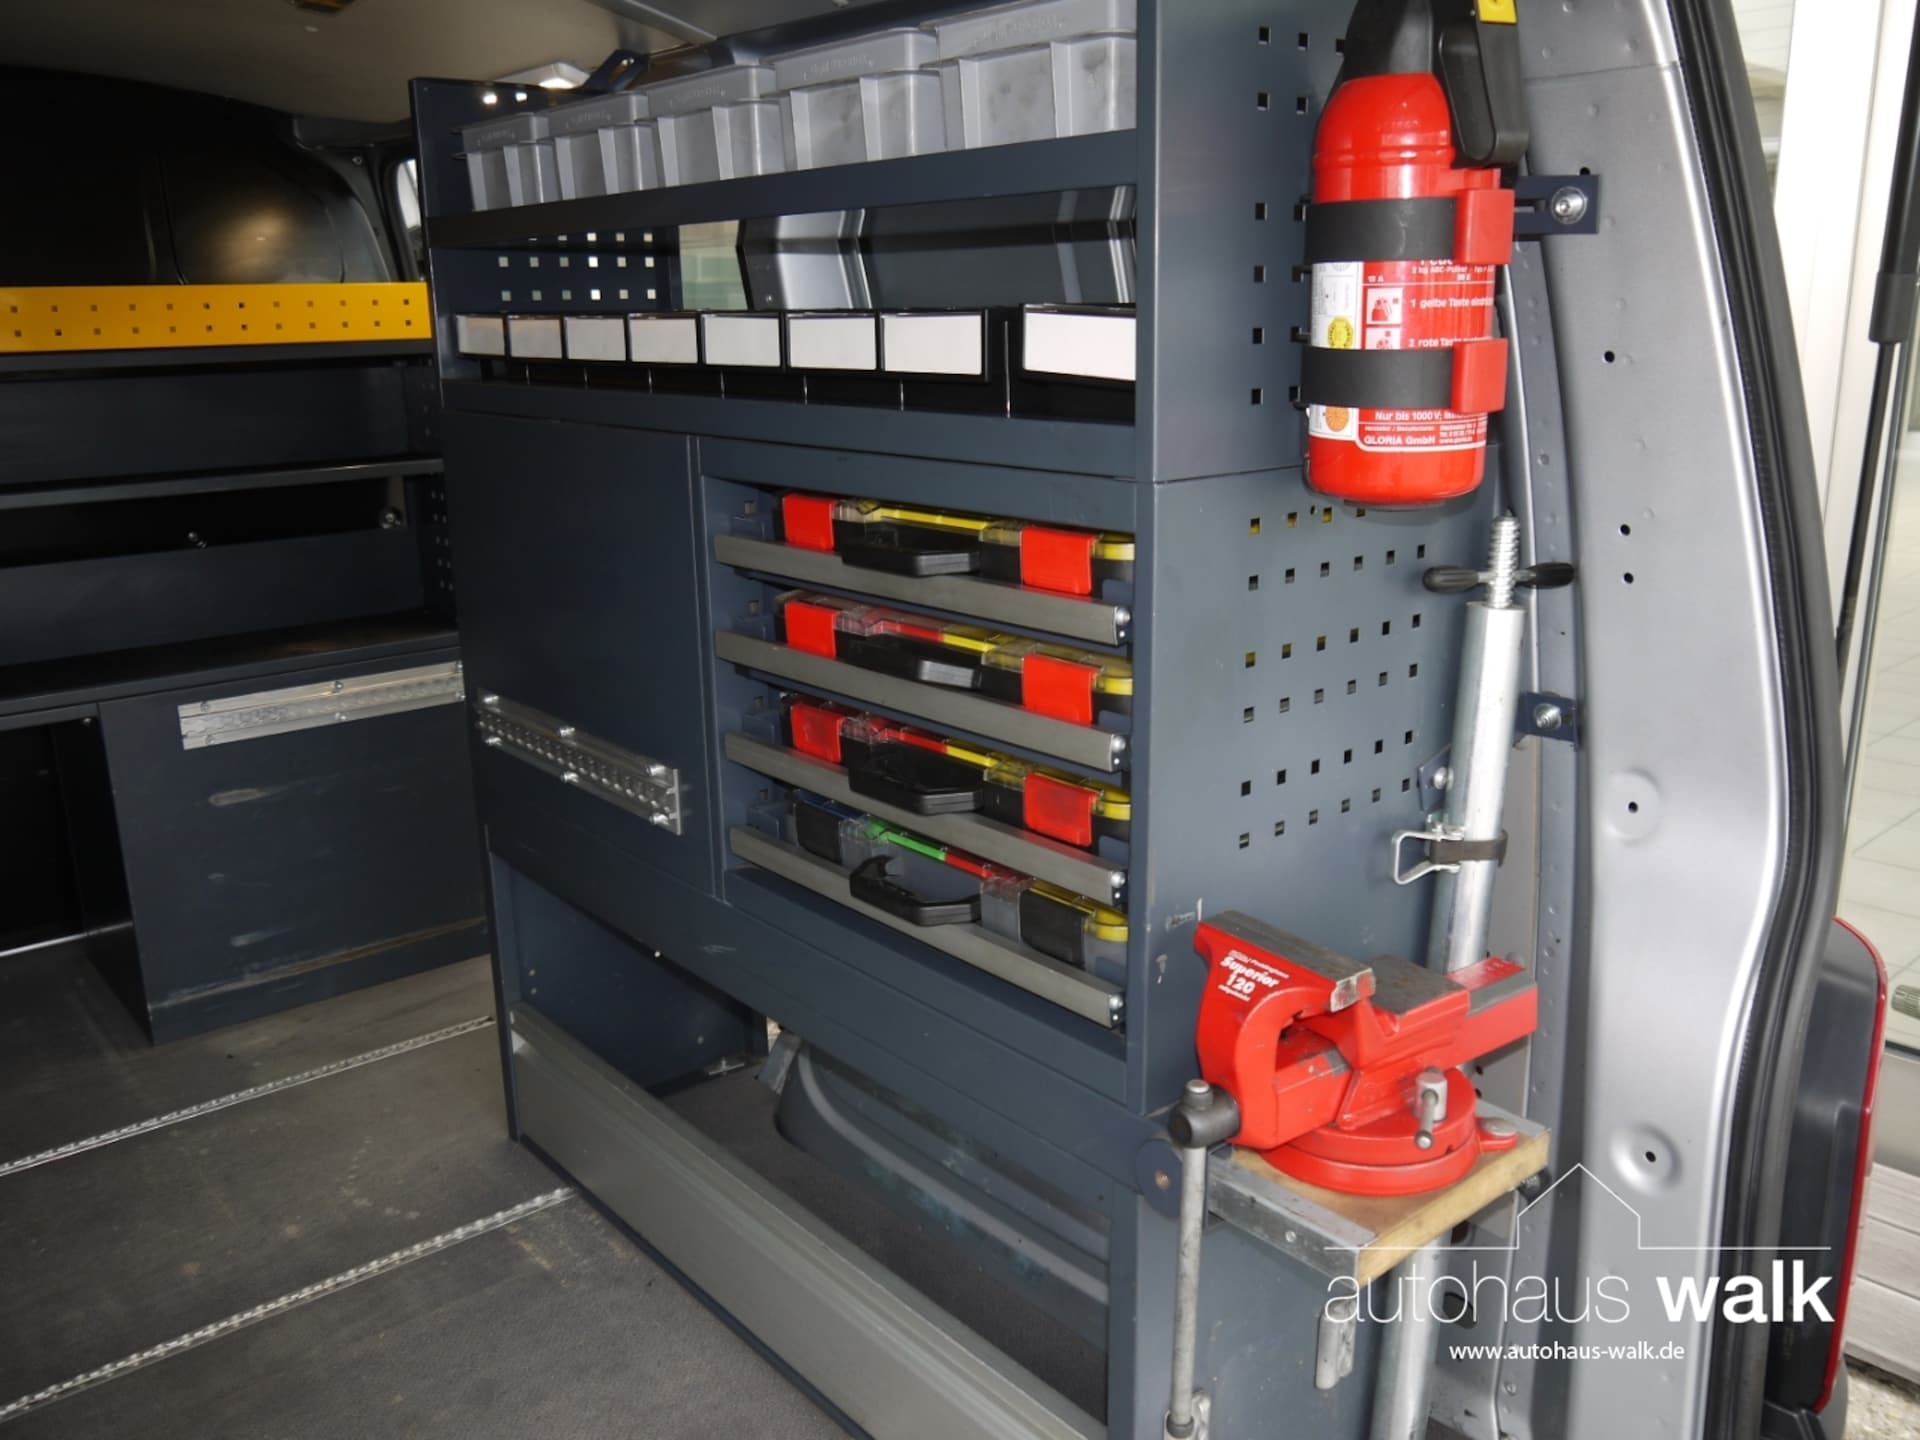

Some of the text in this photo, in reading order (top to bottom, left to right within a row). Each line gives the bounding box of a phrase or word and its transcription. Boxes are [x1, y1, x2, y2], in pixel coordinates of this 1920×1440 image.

[1420, 298, 1447, 309] gelbe
[1418, 338, 1439, 347] rote
[1375, 409, 1394, 420] Nur
[1395, 409, 1409, 420] bis
[1412, 409, 1433, 420] 1000
[1363, 435, 1436, 445] GLORIA GmbH
[1220, 956, 1281, 988] Superior
[1226, 970, 1256, 994] 120
